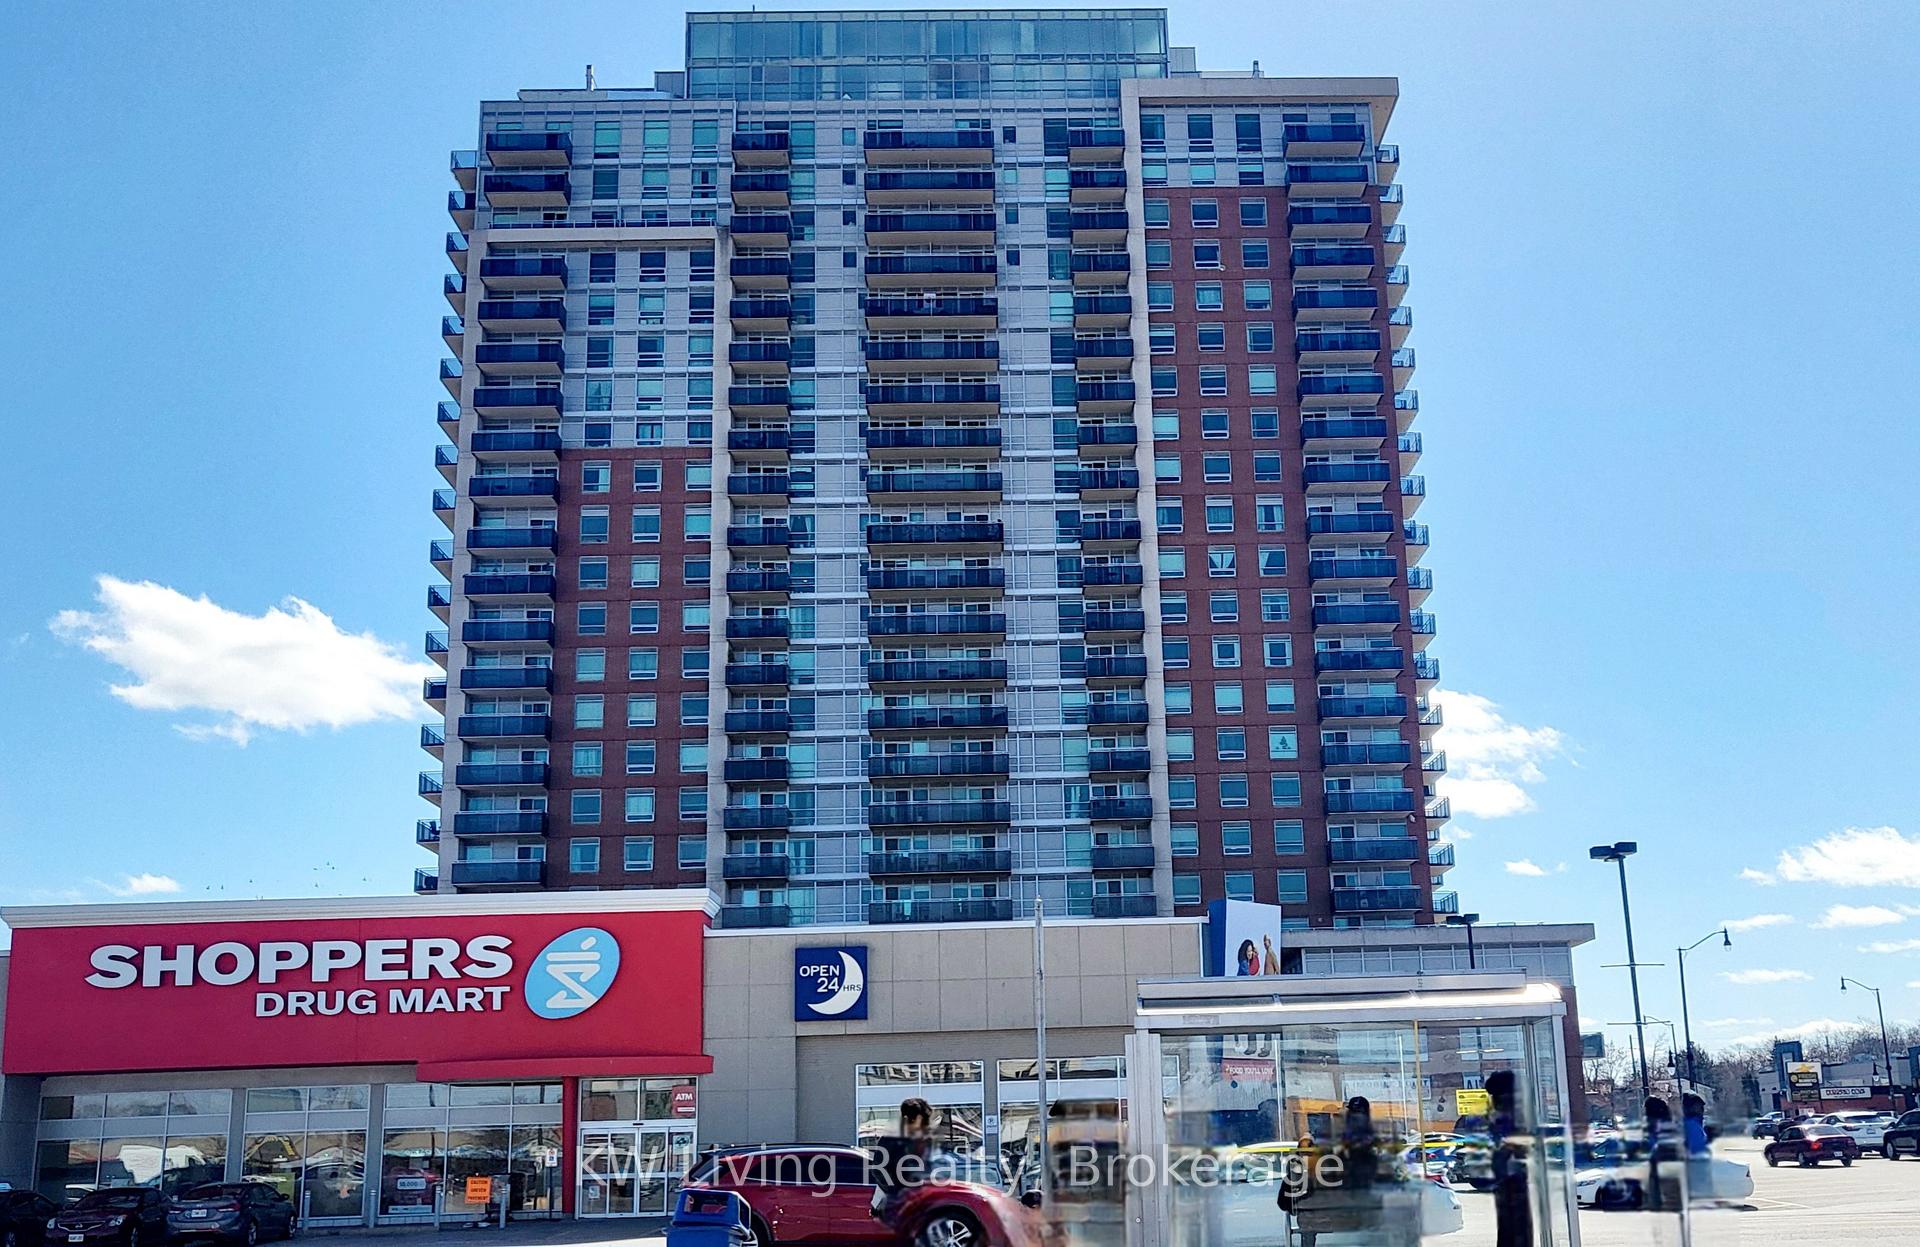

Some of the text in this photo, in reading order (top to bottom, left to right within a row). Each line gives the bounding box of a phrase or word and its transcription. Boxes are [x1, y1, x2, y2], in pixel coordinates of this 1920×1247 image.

[84, 935, 514, 989] SHOPPERS
[799, 964, 840, 977] OPEN
[816, 977, 862, 993] 24 HRS
[255, 986, 512, 1018] DRUG MART
[675, 1093, 693, 1101] ATM
